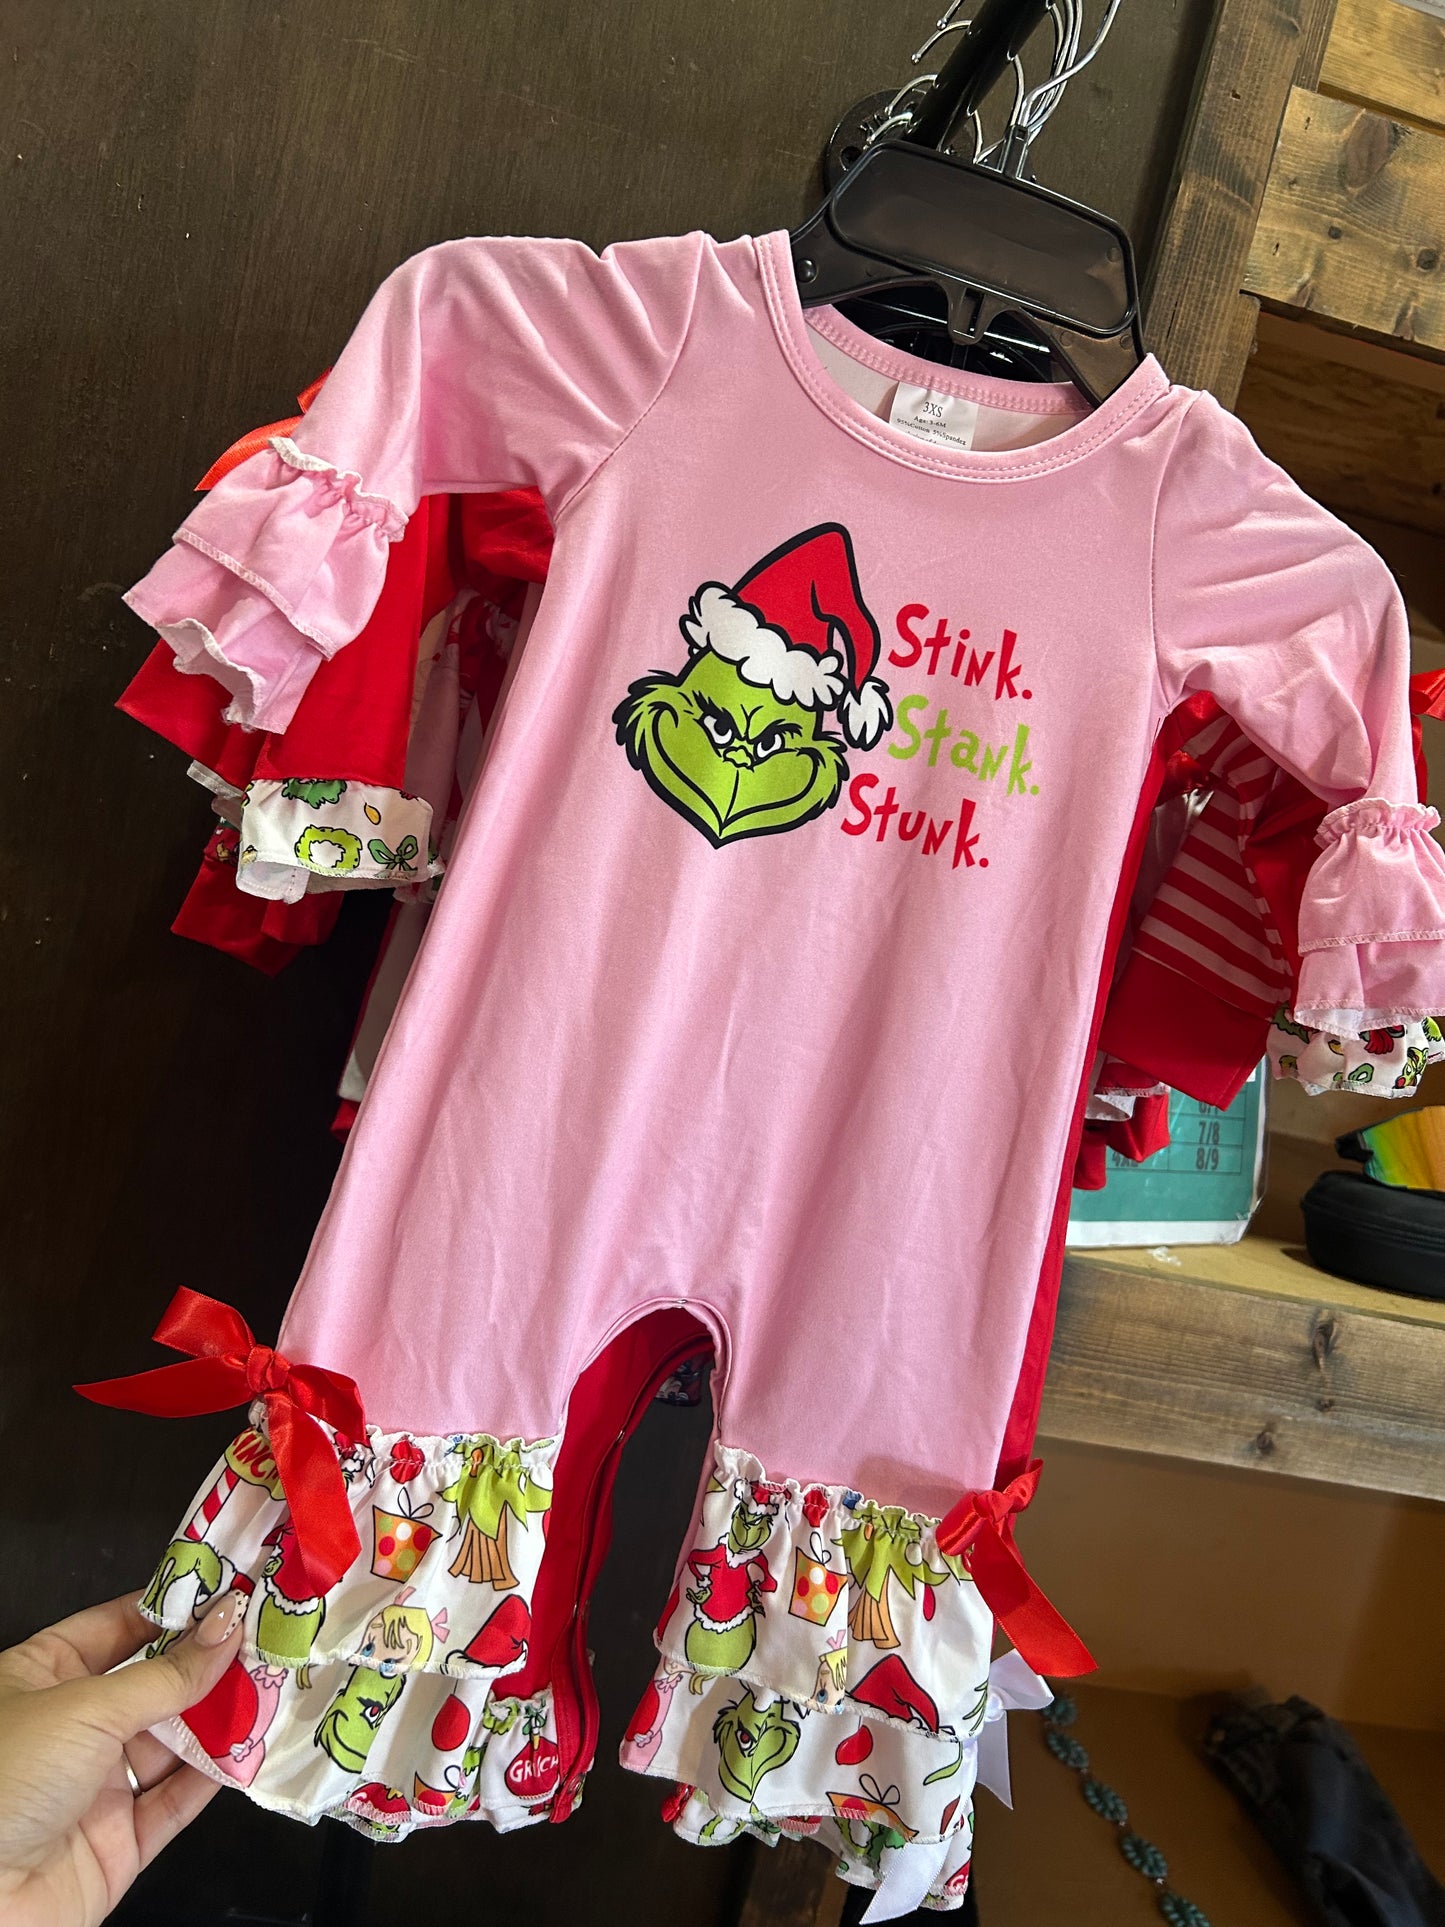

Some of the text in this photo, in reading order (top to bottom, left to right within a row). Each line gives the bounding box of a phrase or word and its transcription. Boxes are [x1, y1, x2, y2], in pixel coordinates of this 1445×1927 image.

[922, 401, 944, 418] 3XS
[887, 603, 1033, 701] Stink.
[887, 694, 1040, 797] Stank.
[840, 773, 989, 870] Stunk.
[1195, 1147, 1220, 1171] 8/9
[1198, 1121, 1221, 1145] 7/8
